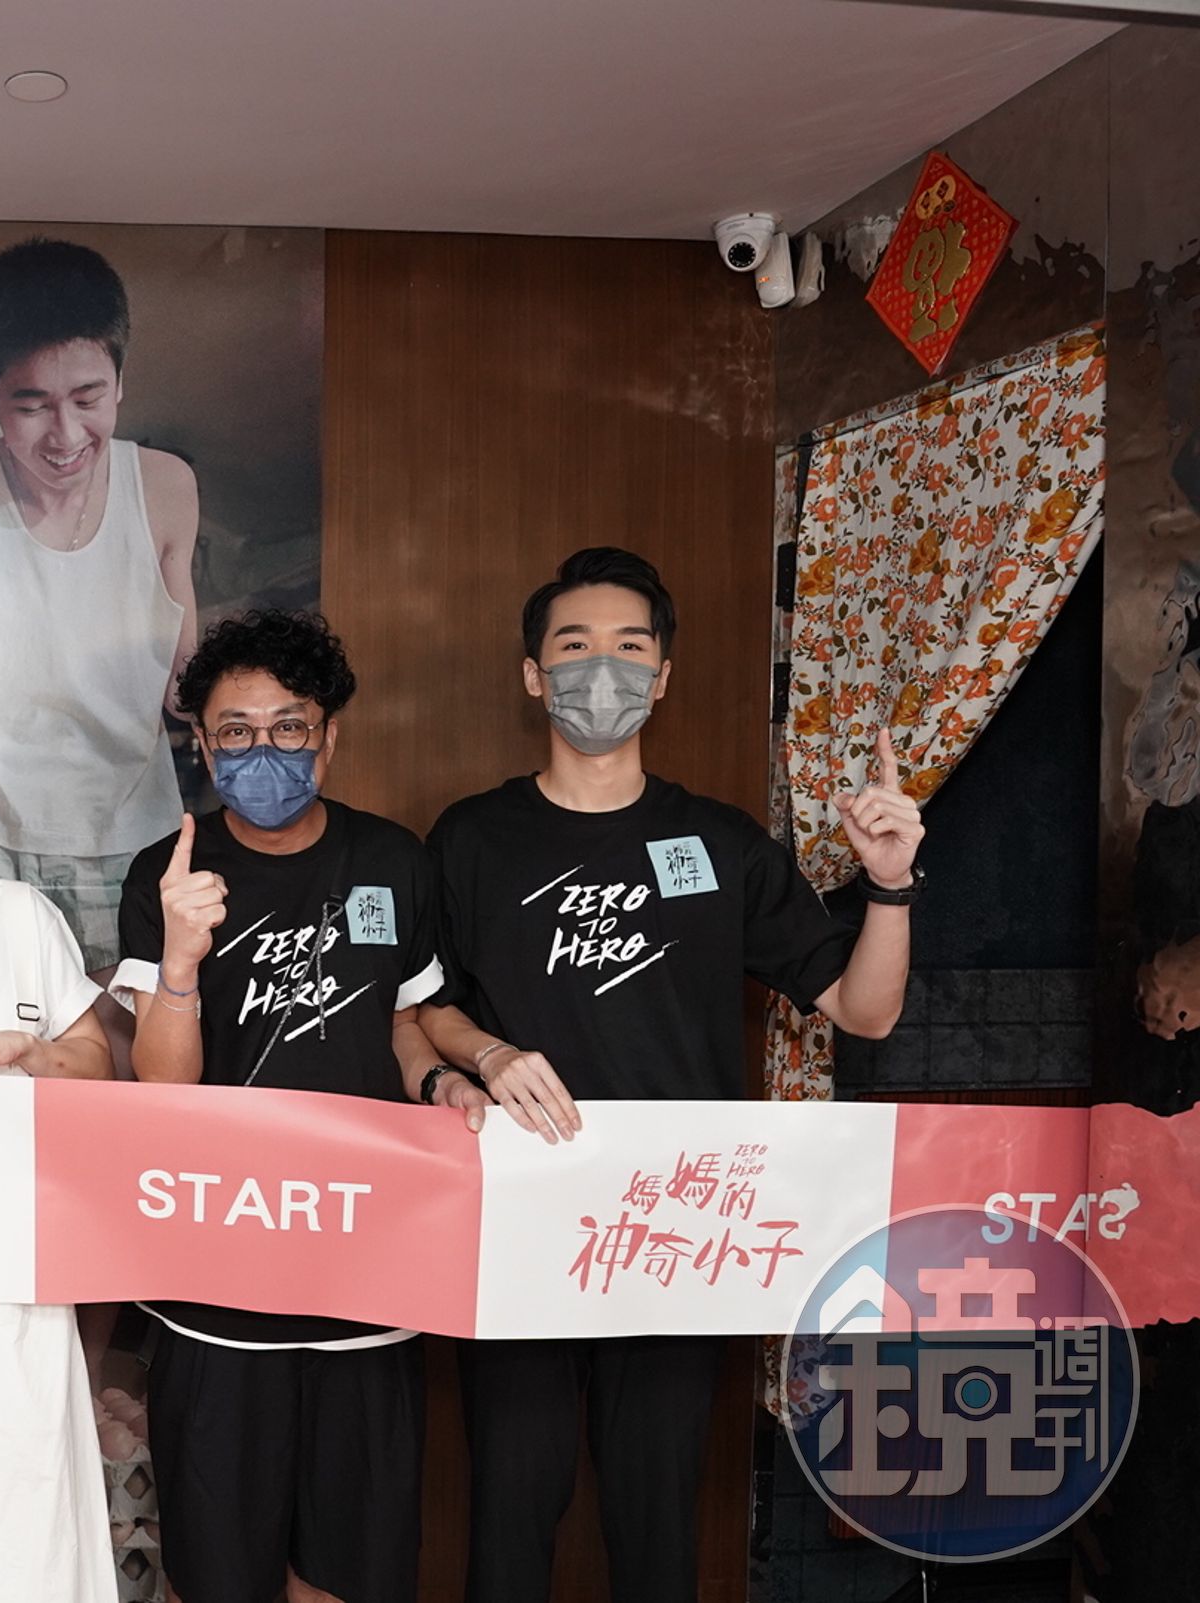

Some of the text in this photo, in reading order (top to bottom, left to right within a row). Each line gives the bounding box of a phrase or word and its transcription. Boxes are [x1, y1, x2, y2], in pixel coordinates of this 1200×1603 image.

[558, 883, 654, 916] ZERO
[252, 925, 343, 964] ZERO
[547, 927, 650, 976] HERO
[579, 917, 617, 938] TO
[238, 976, 344, 1026] HERO
[621, 1151, 756, 1220] 媽媽的
[726, 1162, 766, 1179] HERO
[137, 1168, 373, 1233] START
[568, 1211, 804, 1294] 神奇小子
